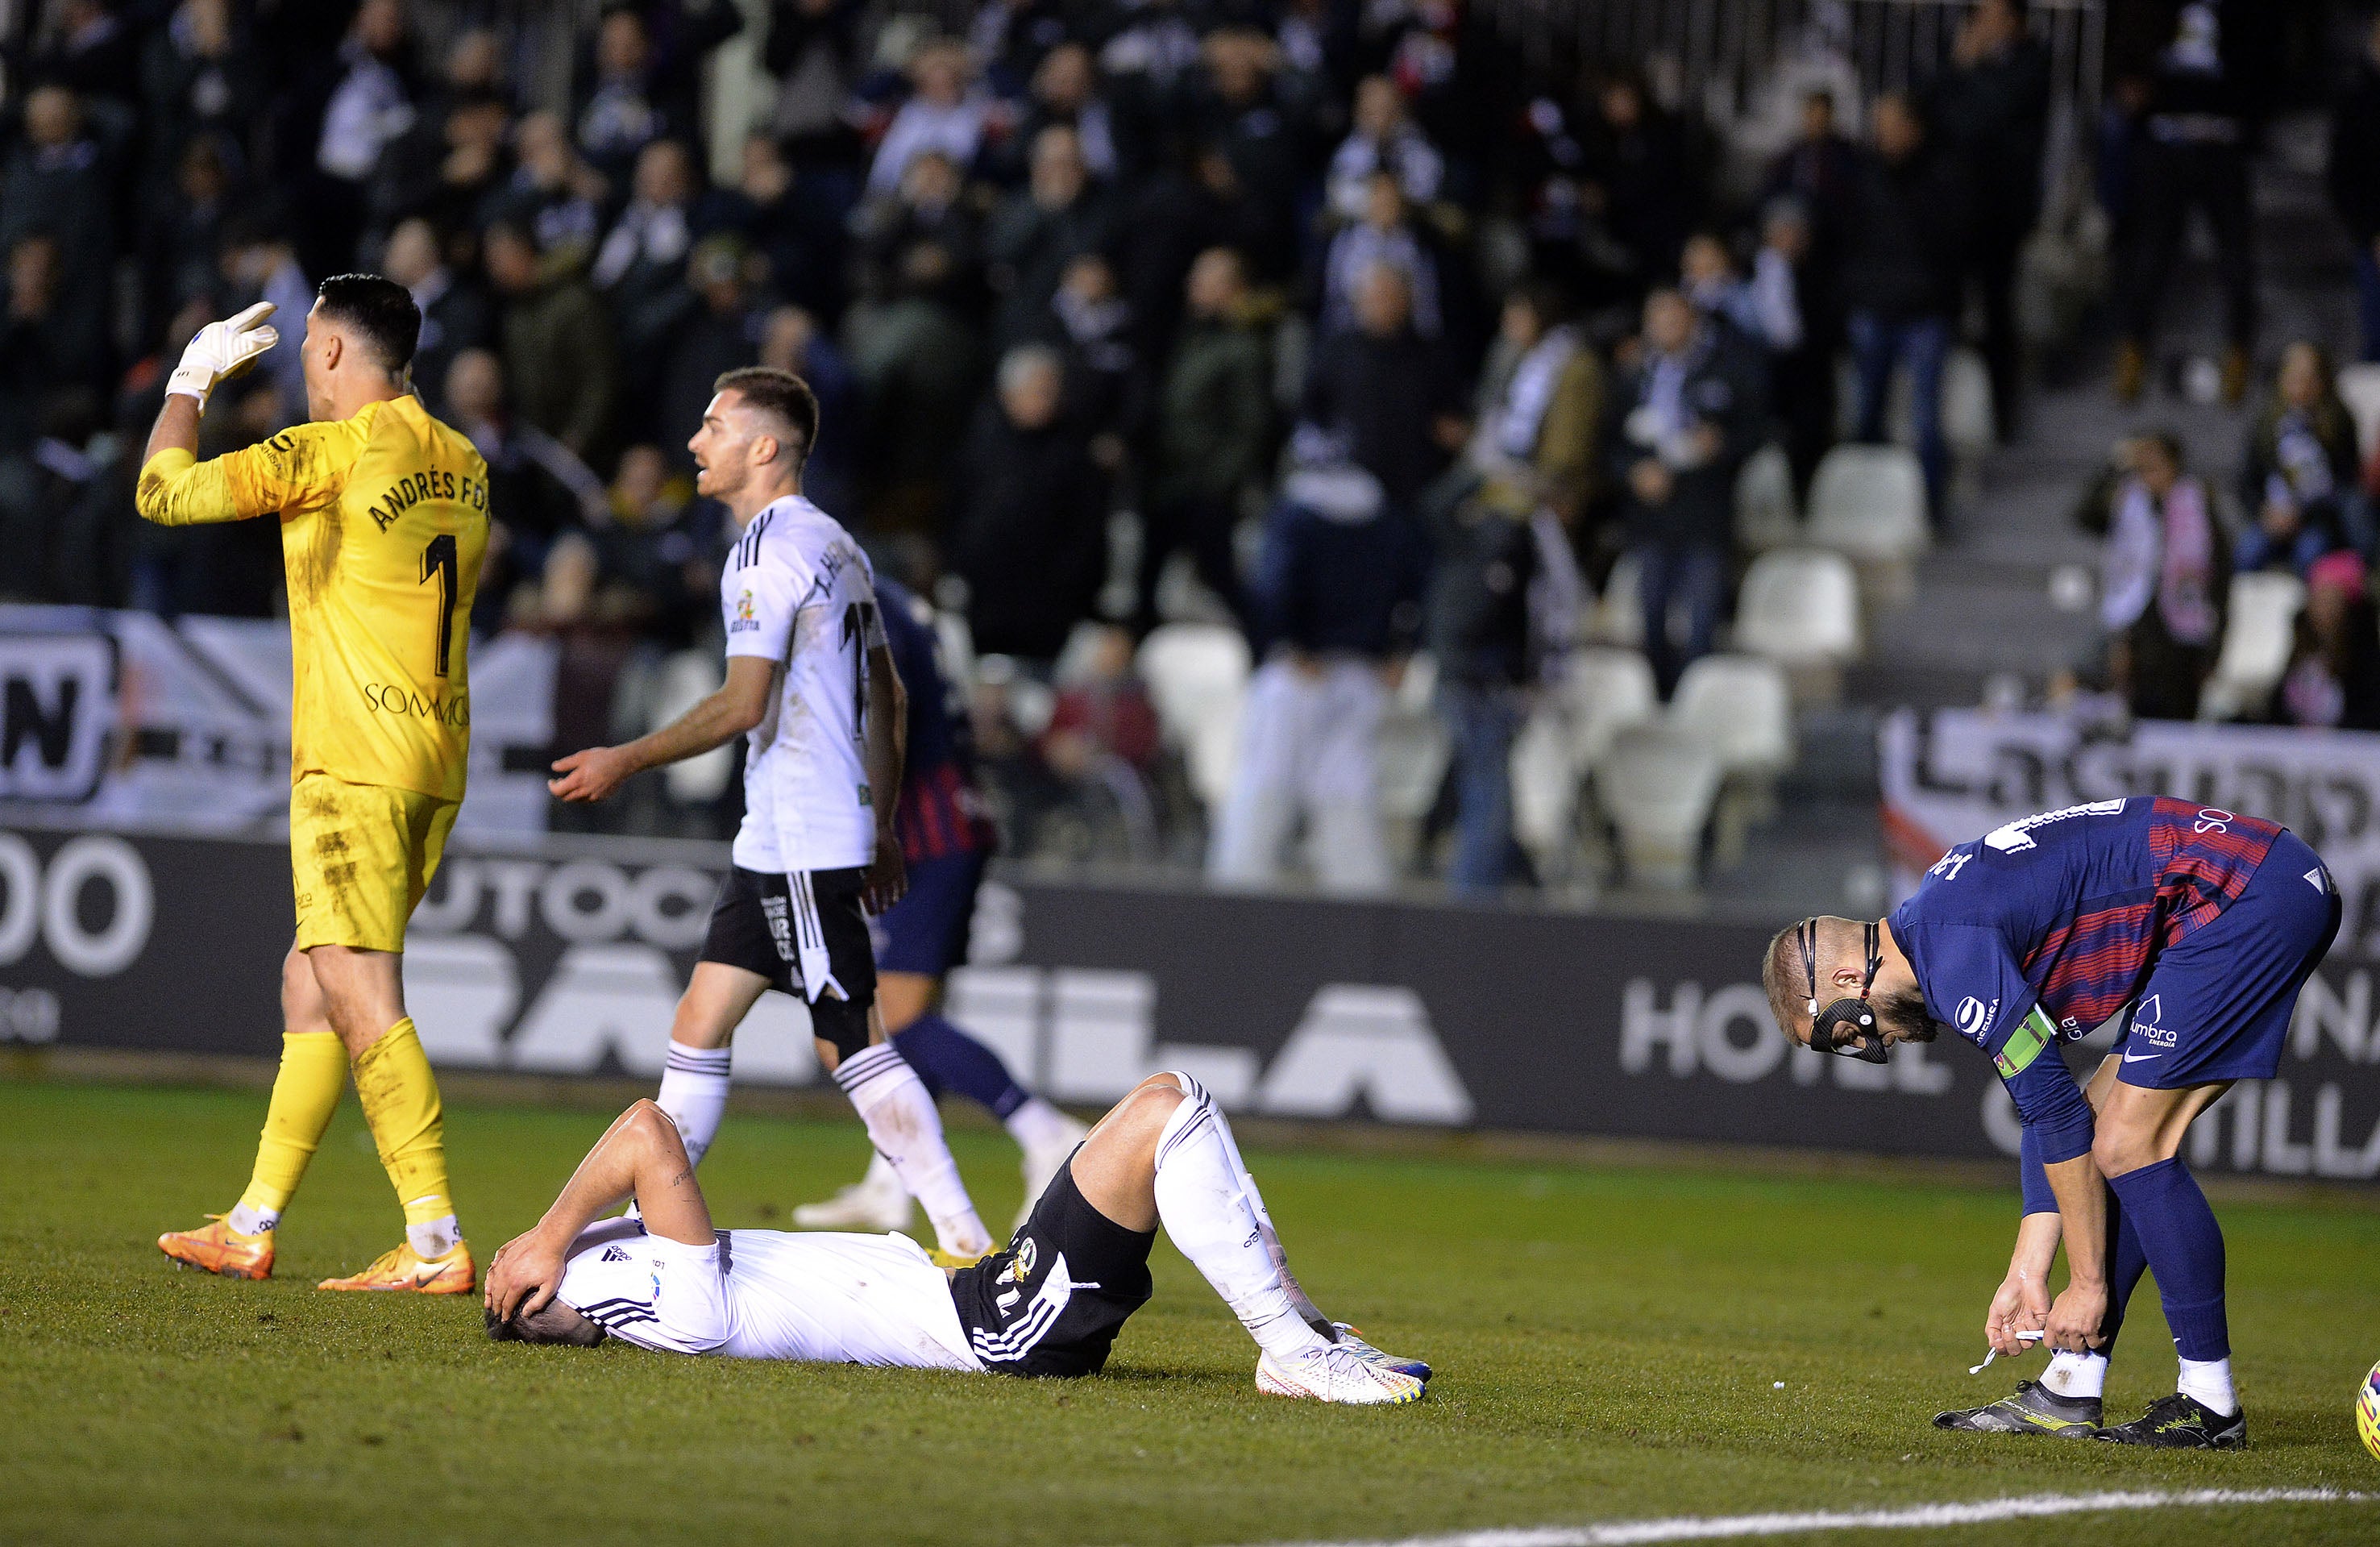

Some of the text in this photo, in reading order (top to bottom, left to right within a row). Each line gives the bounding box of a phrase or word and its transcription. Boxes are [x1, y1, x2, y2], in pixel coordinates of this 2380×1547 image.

[368, 464, 455, 535] ANDRÉS
[417, 534, 458, 677] 1
[364, 683, 471, 727] SOMMO
[2194, 808, 2237, 834] SO
